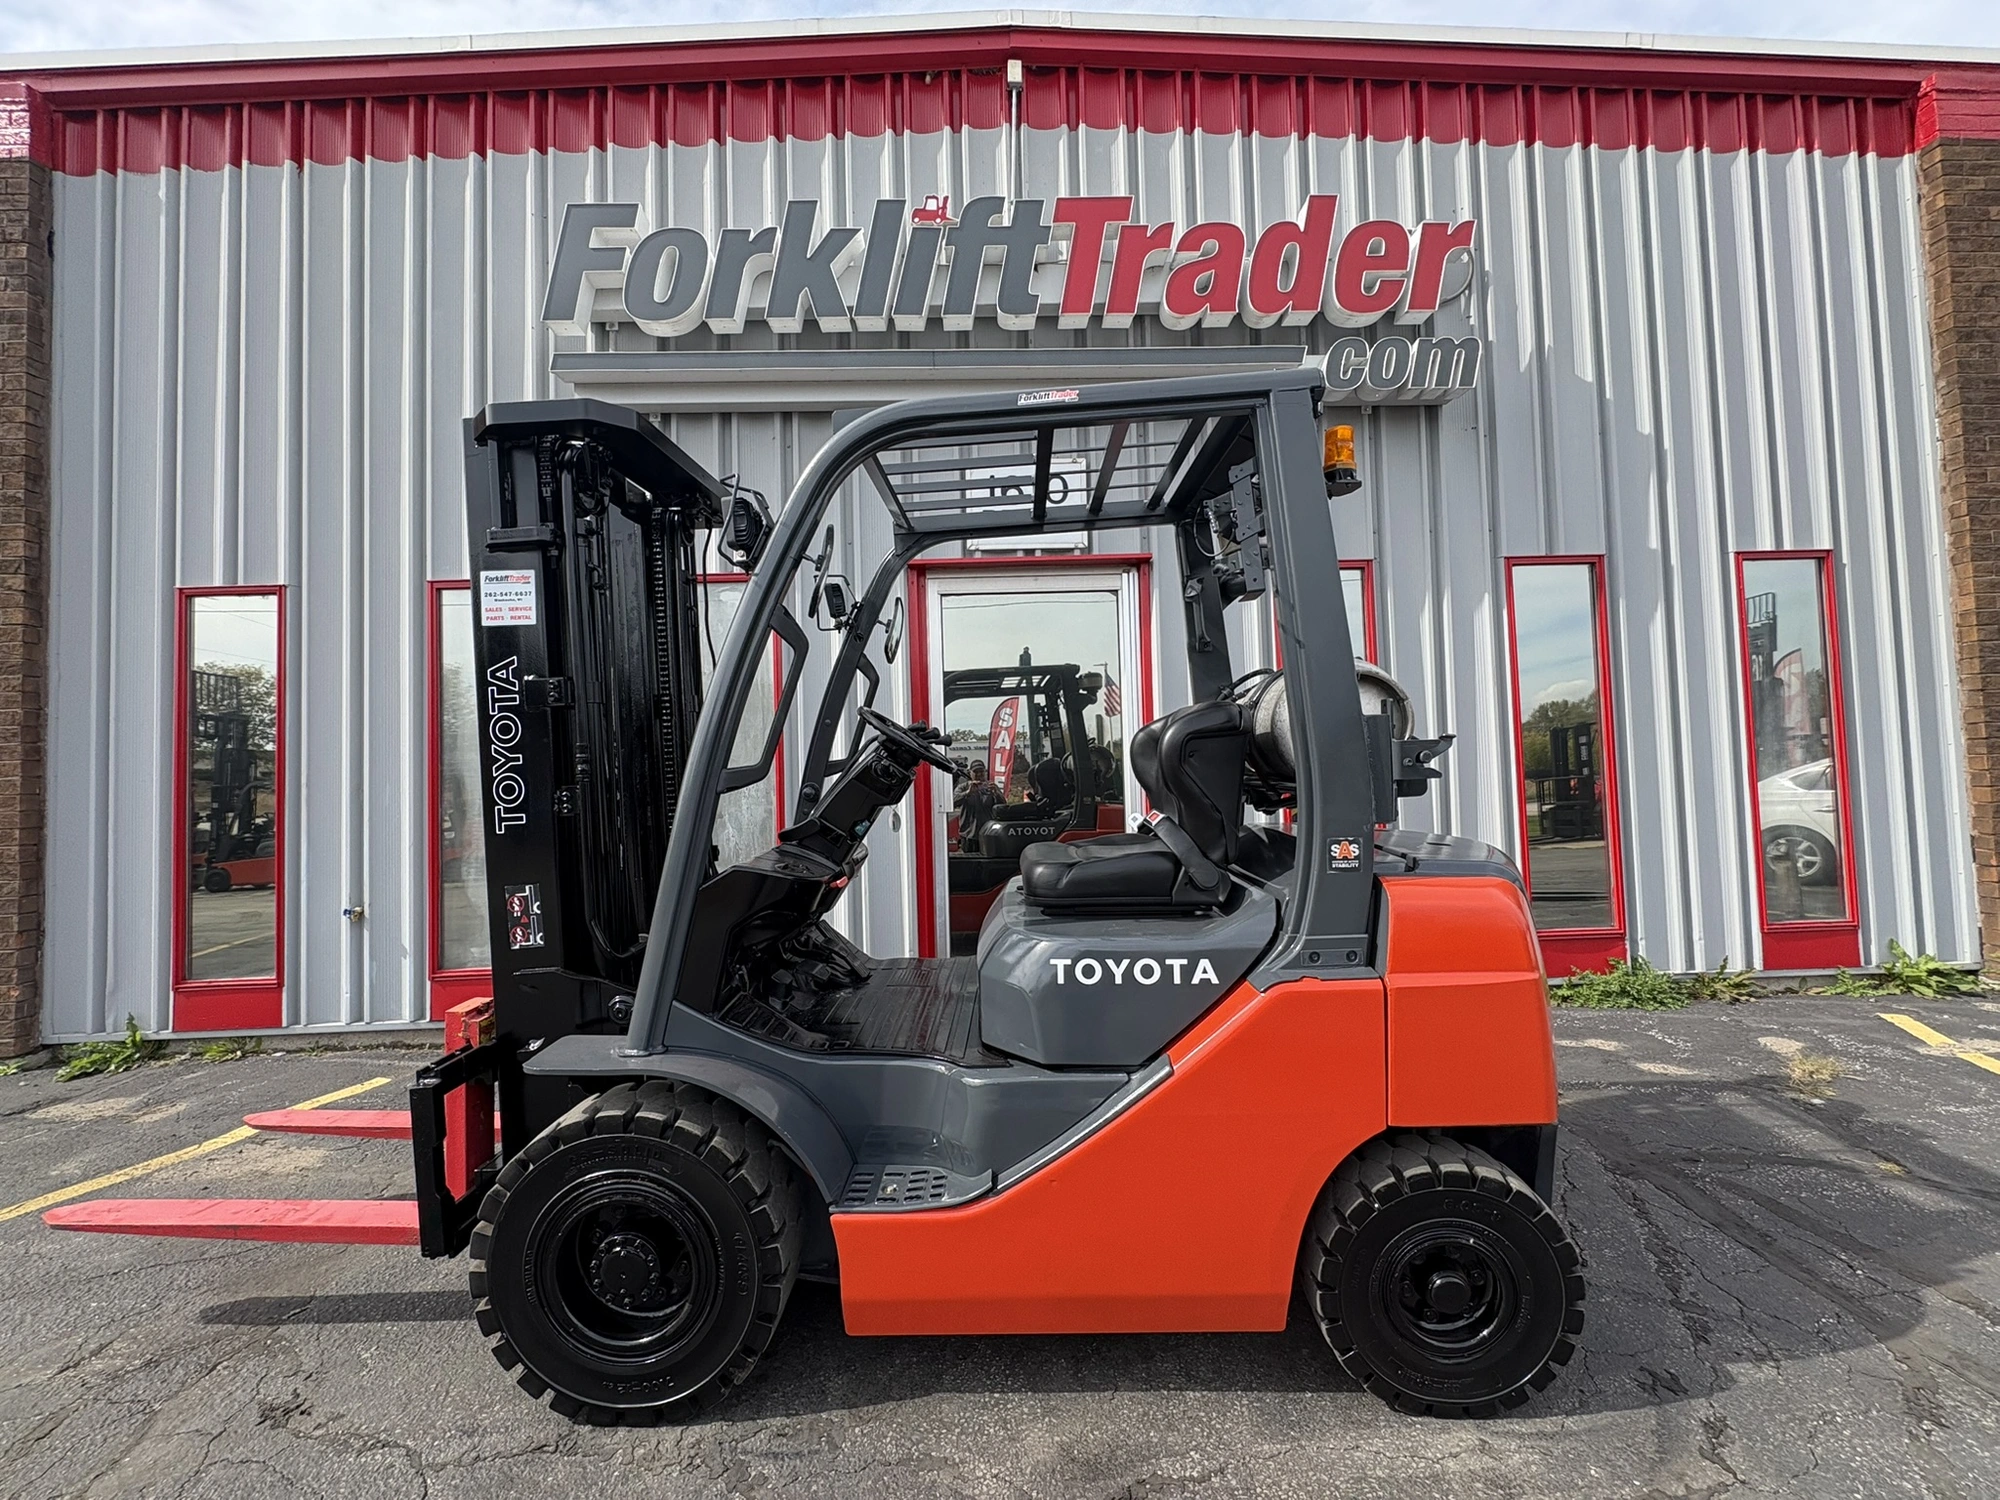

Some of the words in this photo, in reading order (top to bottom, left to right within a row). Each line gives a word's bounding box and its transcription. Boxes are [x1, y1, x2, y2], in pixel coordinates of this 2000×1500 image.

[540, 194, 1478, 325] ForkliftTrader
[1018, 390, 1079, 402] ForkliftTrader
[488, 655, 526, 835] TOYOTA
[994, 707, 1014, 795] SALE
[1331, 841, 1360, 859] SAS
[1049, 957, 1220, 986] TOYOTA
